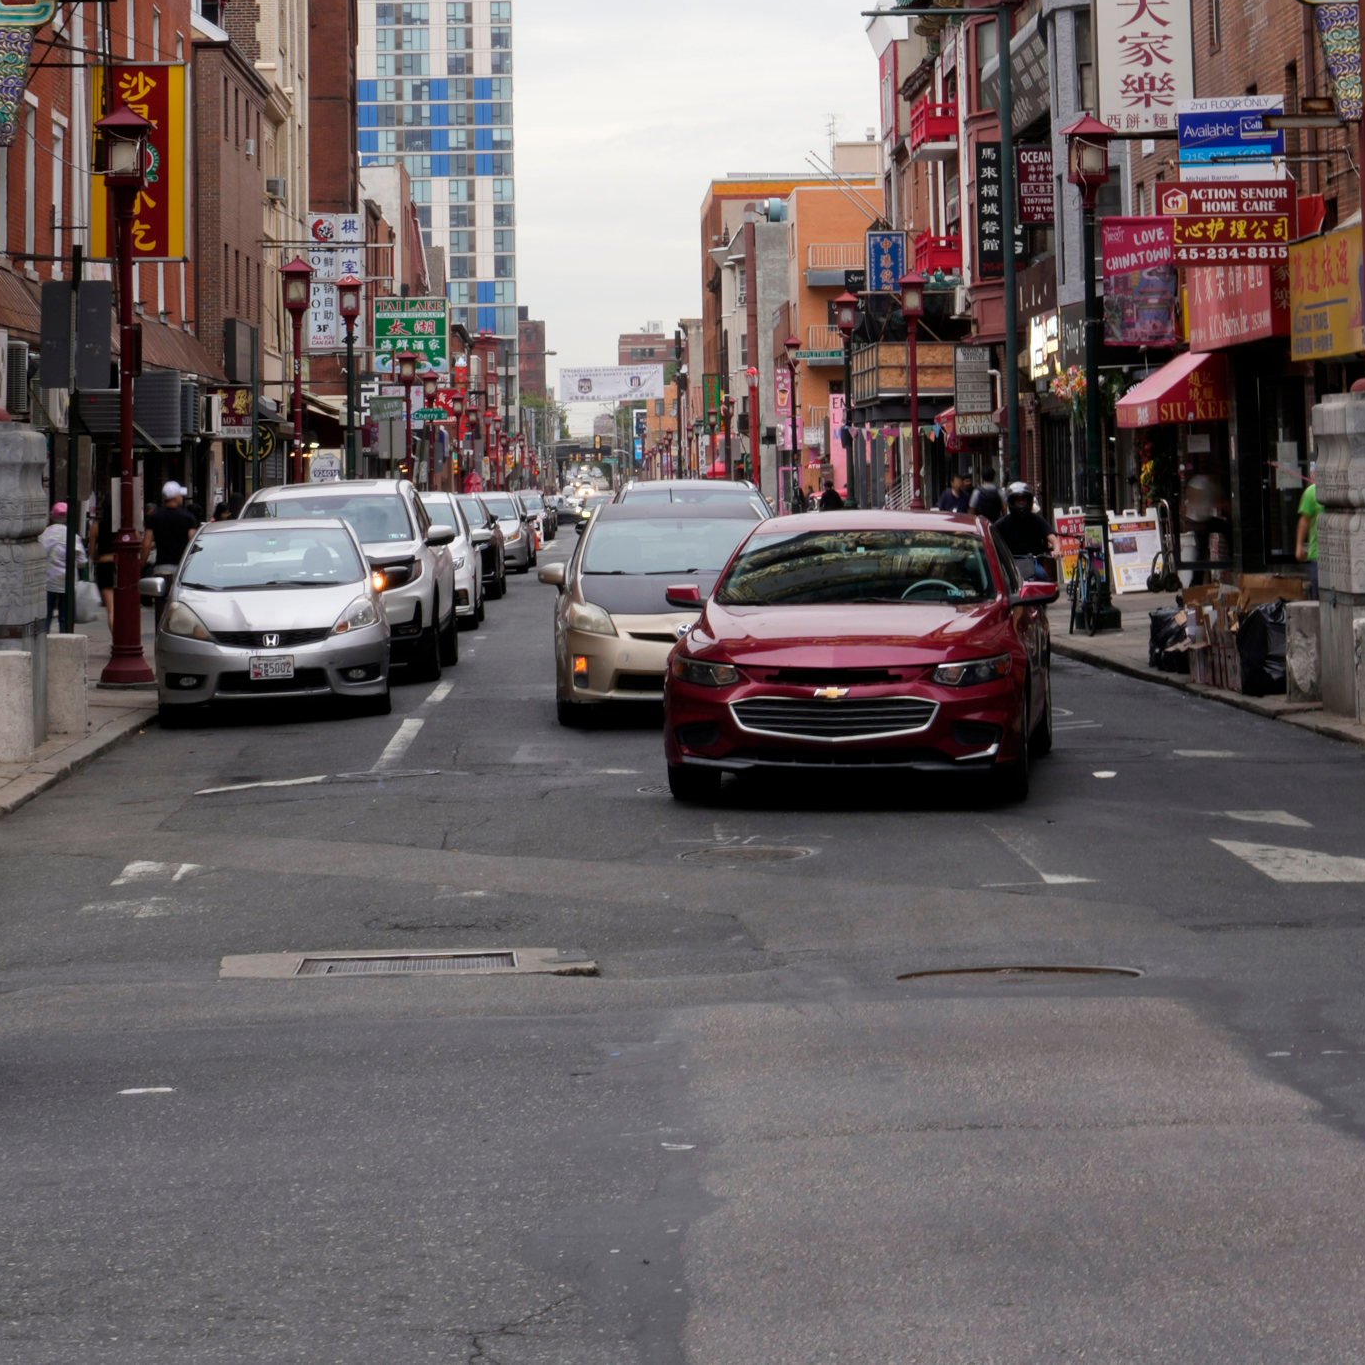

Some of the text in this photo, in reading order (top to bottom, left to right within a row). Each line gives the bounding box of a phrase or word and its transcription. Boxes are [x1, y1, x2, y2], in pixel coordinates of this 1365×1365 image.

[1190, 97, 1270, 111] 2nd FLOOR ONLY
[1183, 123, 1235, 138] Available
[1244, 121, 1263, 131] Colli
[1020, 151, 1051, 164] OCEAN
[1190, 187, 1288, 200] ACTION SENIOR
[1202, 200, 1277, 212] HOME CARE
[1105, 245, 1171, 271] CHINATOWN
[1173, 246, 1288, 260] 45-234-8815
[377, 300, 445, 312] TAI LAKE
[316, 324, 330, 333] 3F
[415, 412, 438, 421] Cherry
[1160, 402, 1187, 422] SIU
